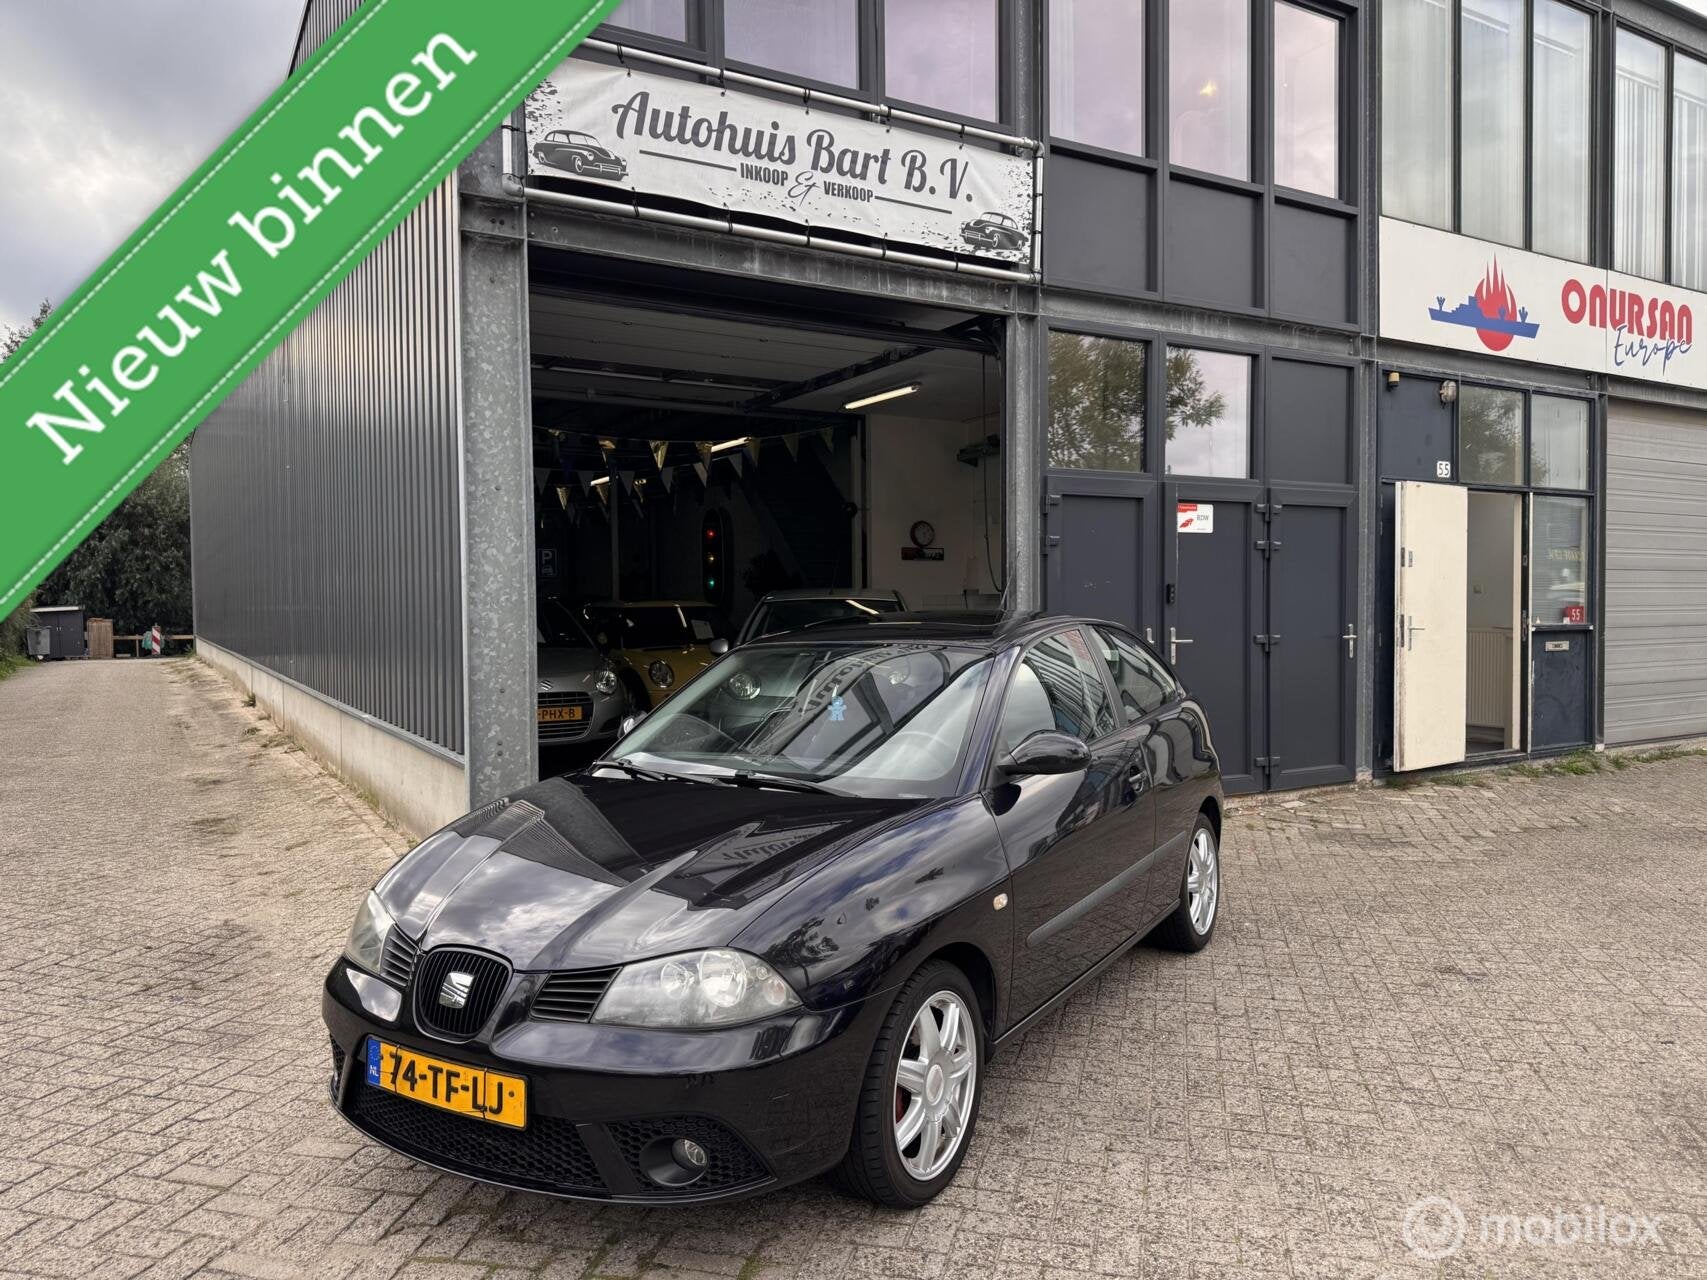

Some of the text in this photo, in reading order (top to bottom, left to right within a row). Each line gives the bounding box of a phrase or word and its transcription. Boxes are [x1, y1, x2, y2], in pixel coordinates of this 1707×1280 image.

[611, 91, 974, 203] Autohuis Bart B.V.
[740, 161, 789, 186] INKOOP
[823, 183, 874, 202] VERKOOP
[1561, 278, 1693, 346] ONURSAN
[1613, 324, 1693, 376] Europe
[1438, 462, 1450, 476] 55
[541, 550, 553, 565] P
[1571, 608, 1581, 621] 55
[369, 1064, 379, 1077] NL
